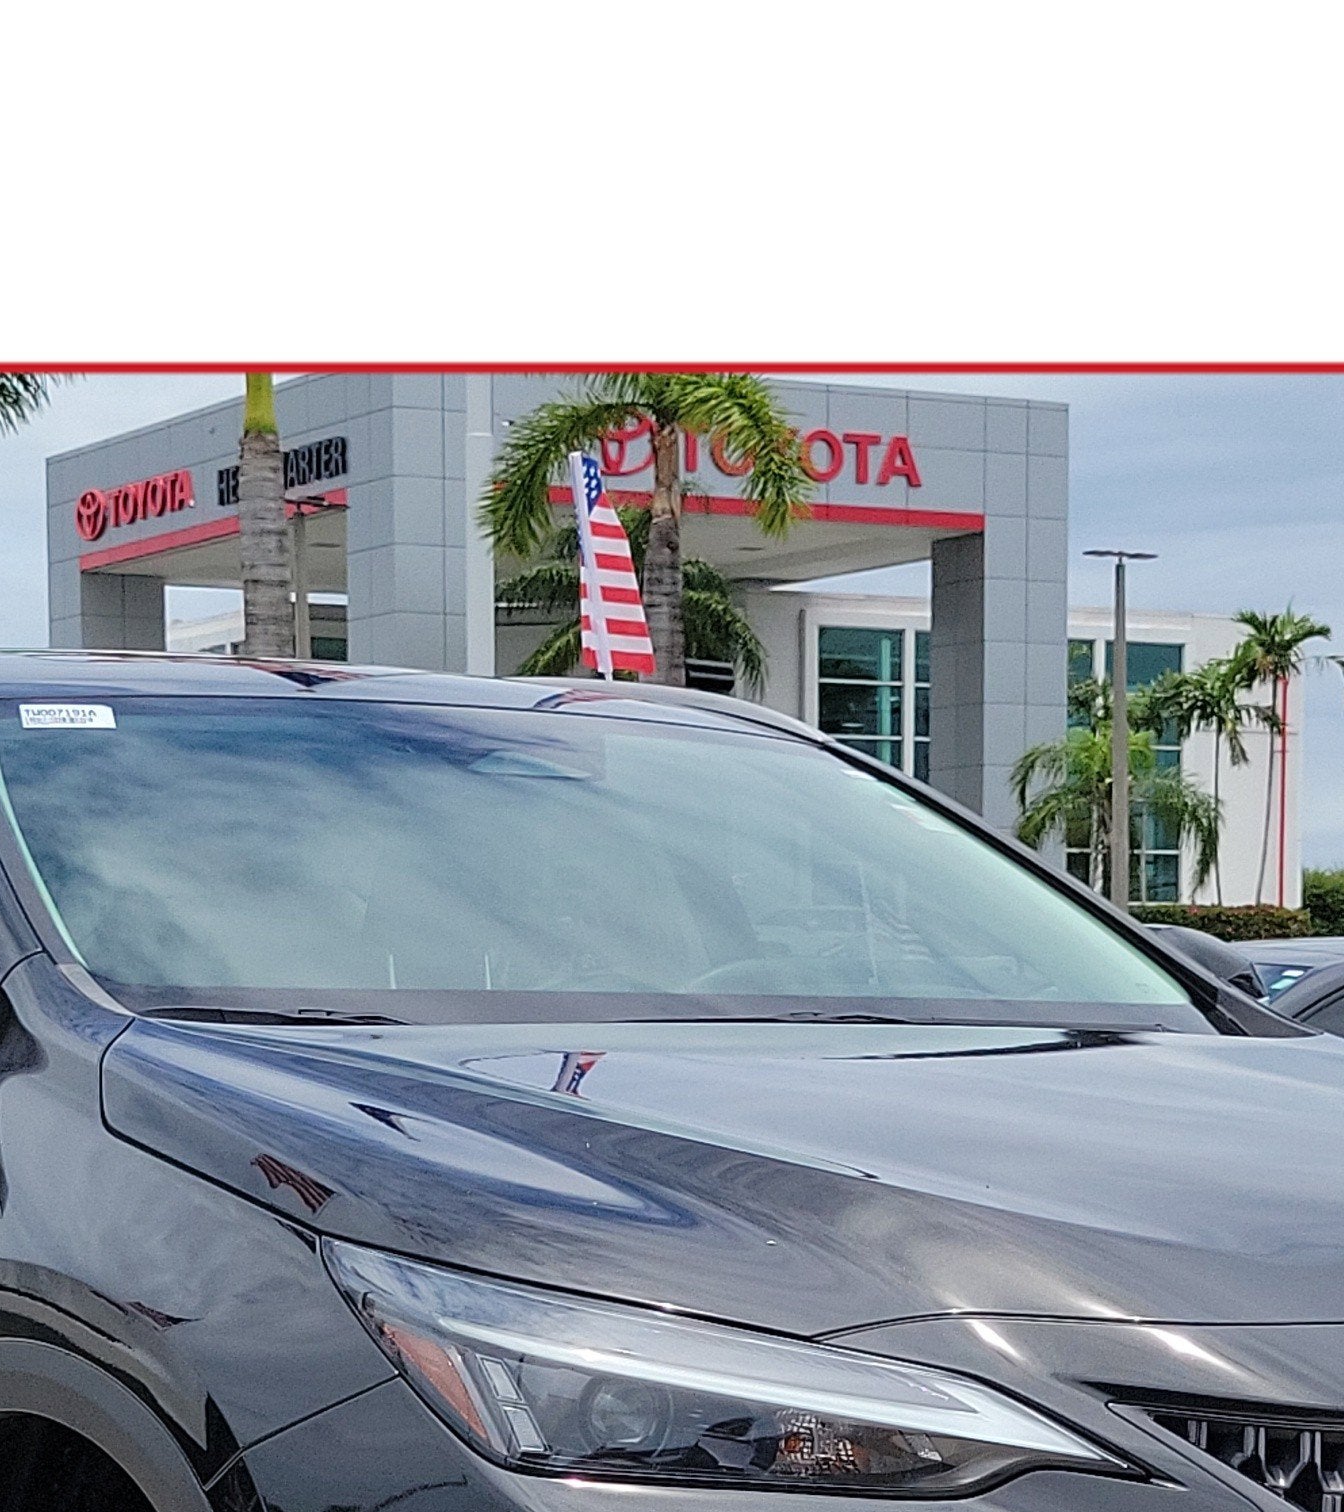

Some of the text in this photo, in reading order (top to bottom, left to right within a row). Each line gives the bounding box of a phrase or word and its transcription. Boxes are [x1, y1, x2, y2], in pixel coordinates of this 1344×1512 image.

[217, 436, 347, 506] HEARTER
[680, 424, 923, 488] TOOTA
[107, 468, 195, 527] TOYOTA
